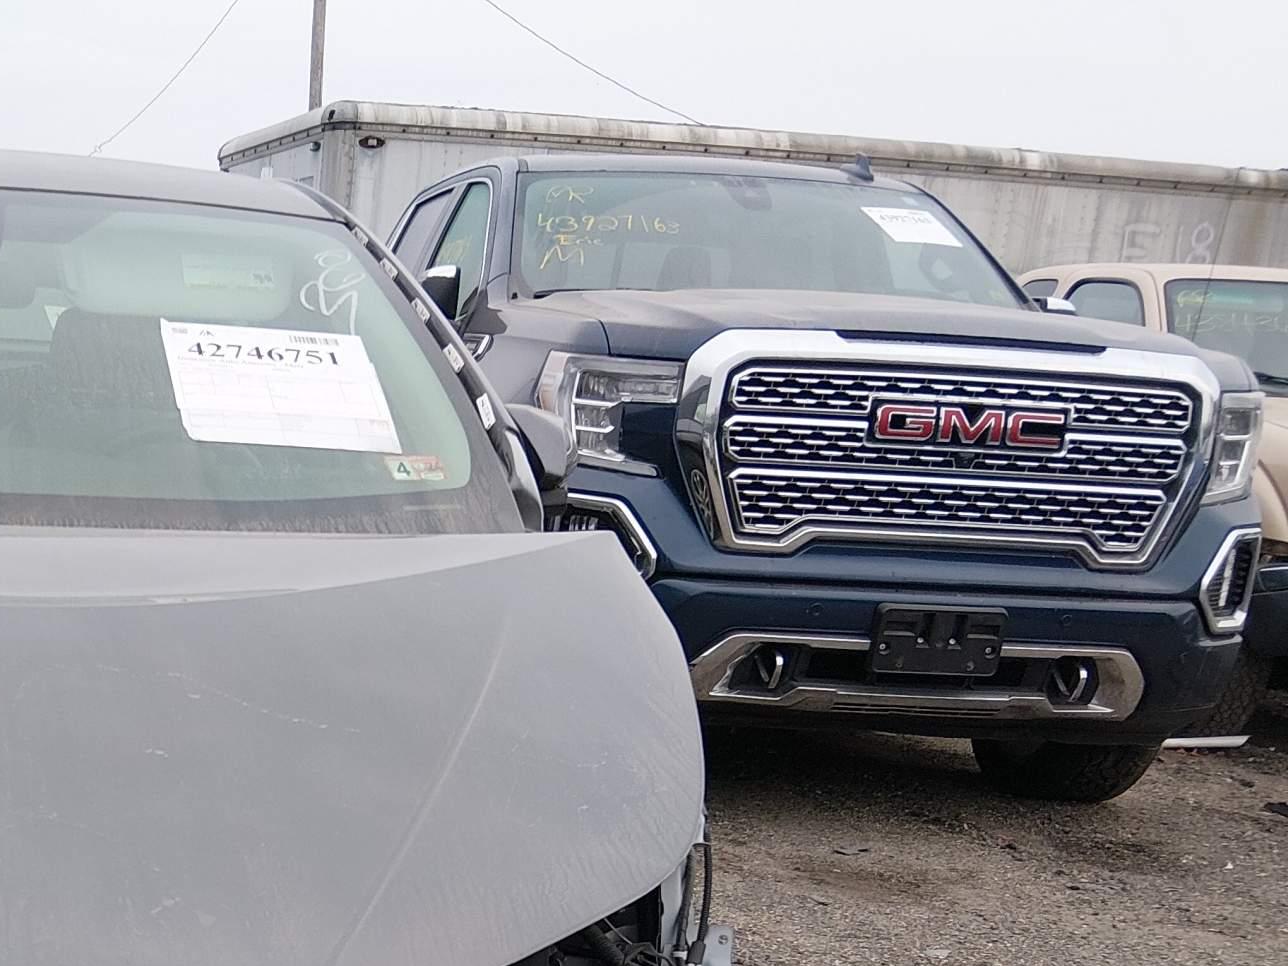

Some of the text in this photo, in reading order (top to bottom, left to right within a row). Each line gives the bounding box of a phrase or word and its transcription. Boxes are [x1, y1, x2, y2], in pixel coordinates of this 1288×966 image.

[536, 213, 680, 234] 43927163
[187, 341, 340, 366] 42746751
[875, 404, 1065, 449] GMC
